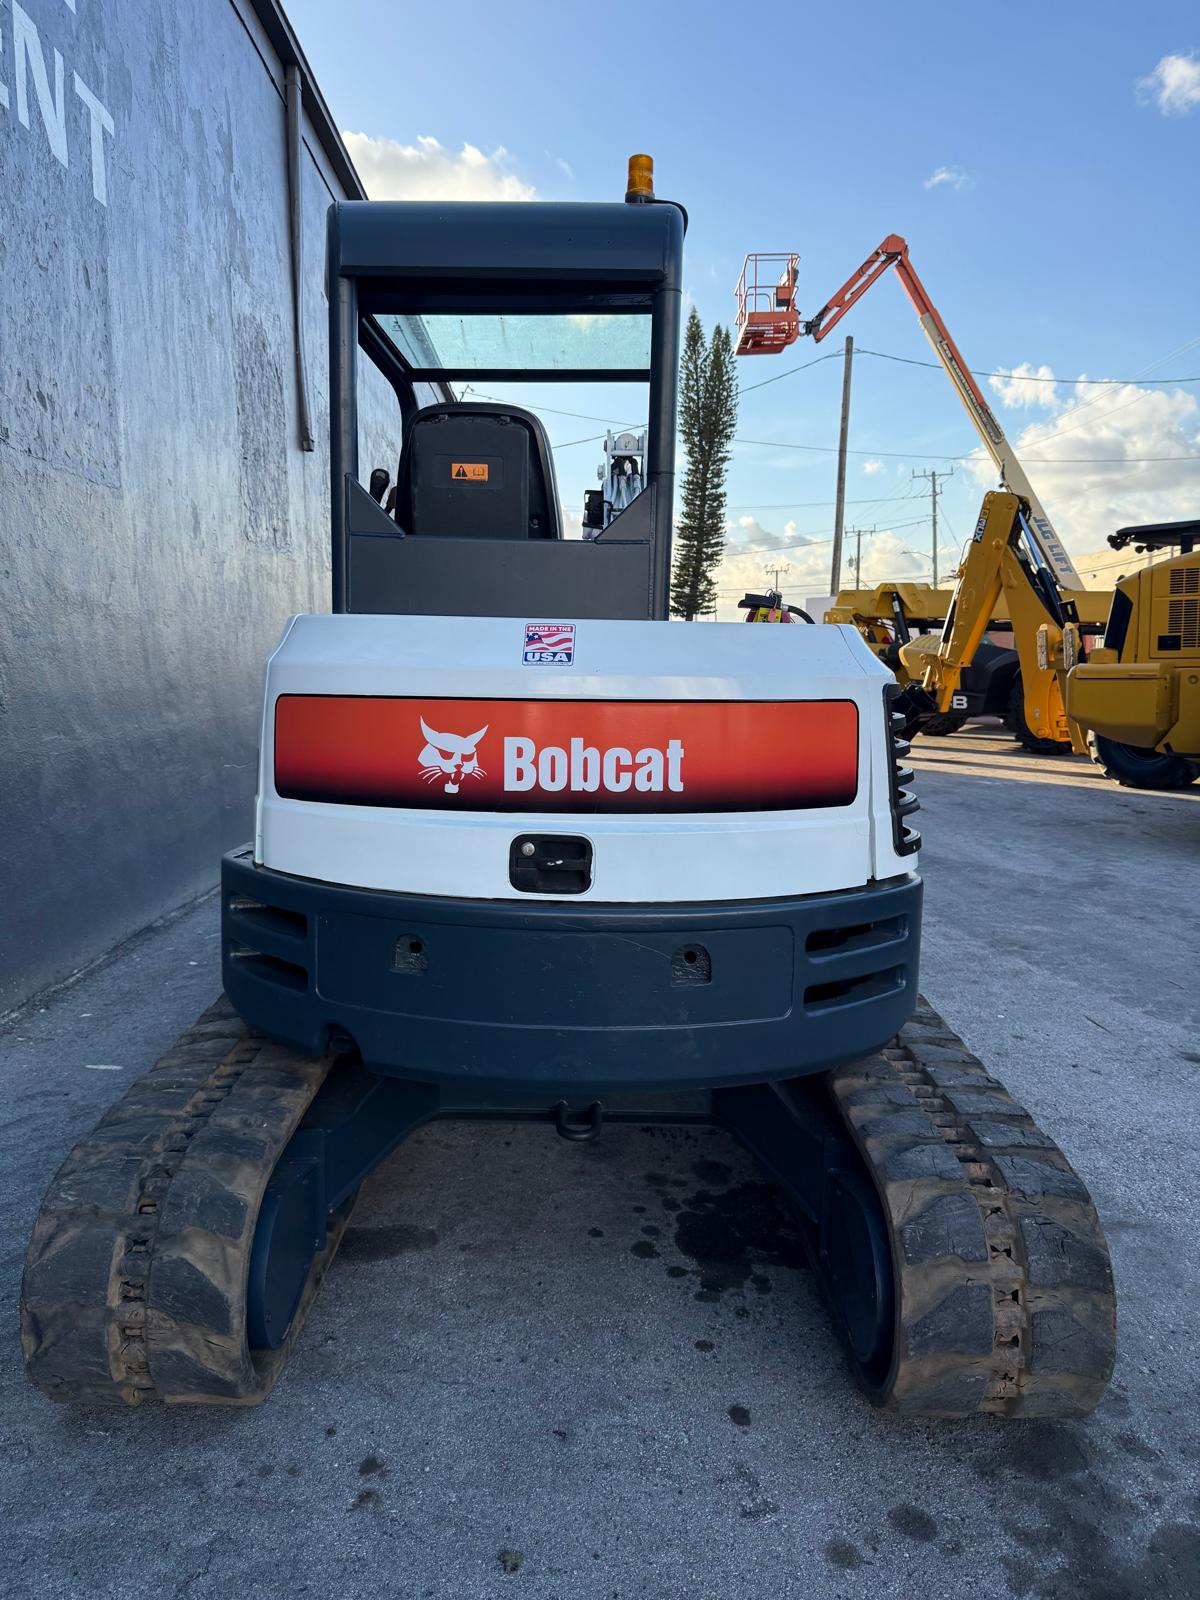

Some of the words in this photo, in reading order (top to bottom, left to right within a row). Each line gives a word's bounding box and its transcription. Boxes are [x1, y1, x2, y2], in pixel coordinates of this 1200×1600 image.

[0, 0, 115, 207] NT
[1031, 516, 1056, 540] JLG
[1047, 543, 1073, 573] LIFT
[526, 652, 569, 662] USA
[503, 736, 684, 793] Bobcat
